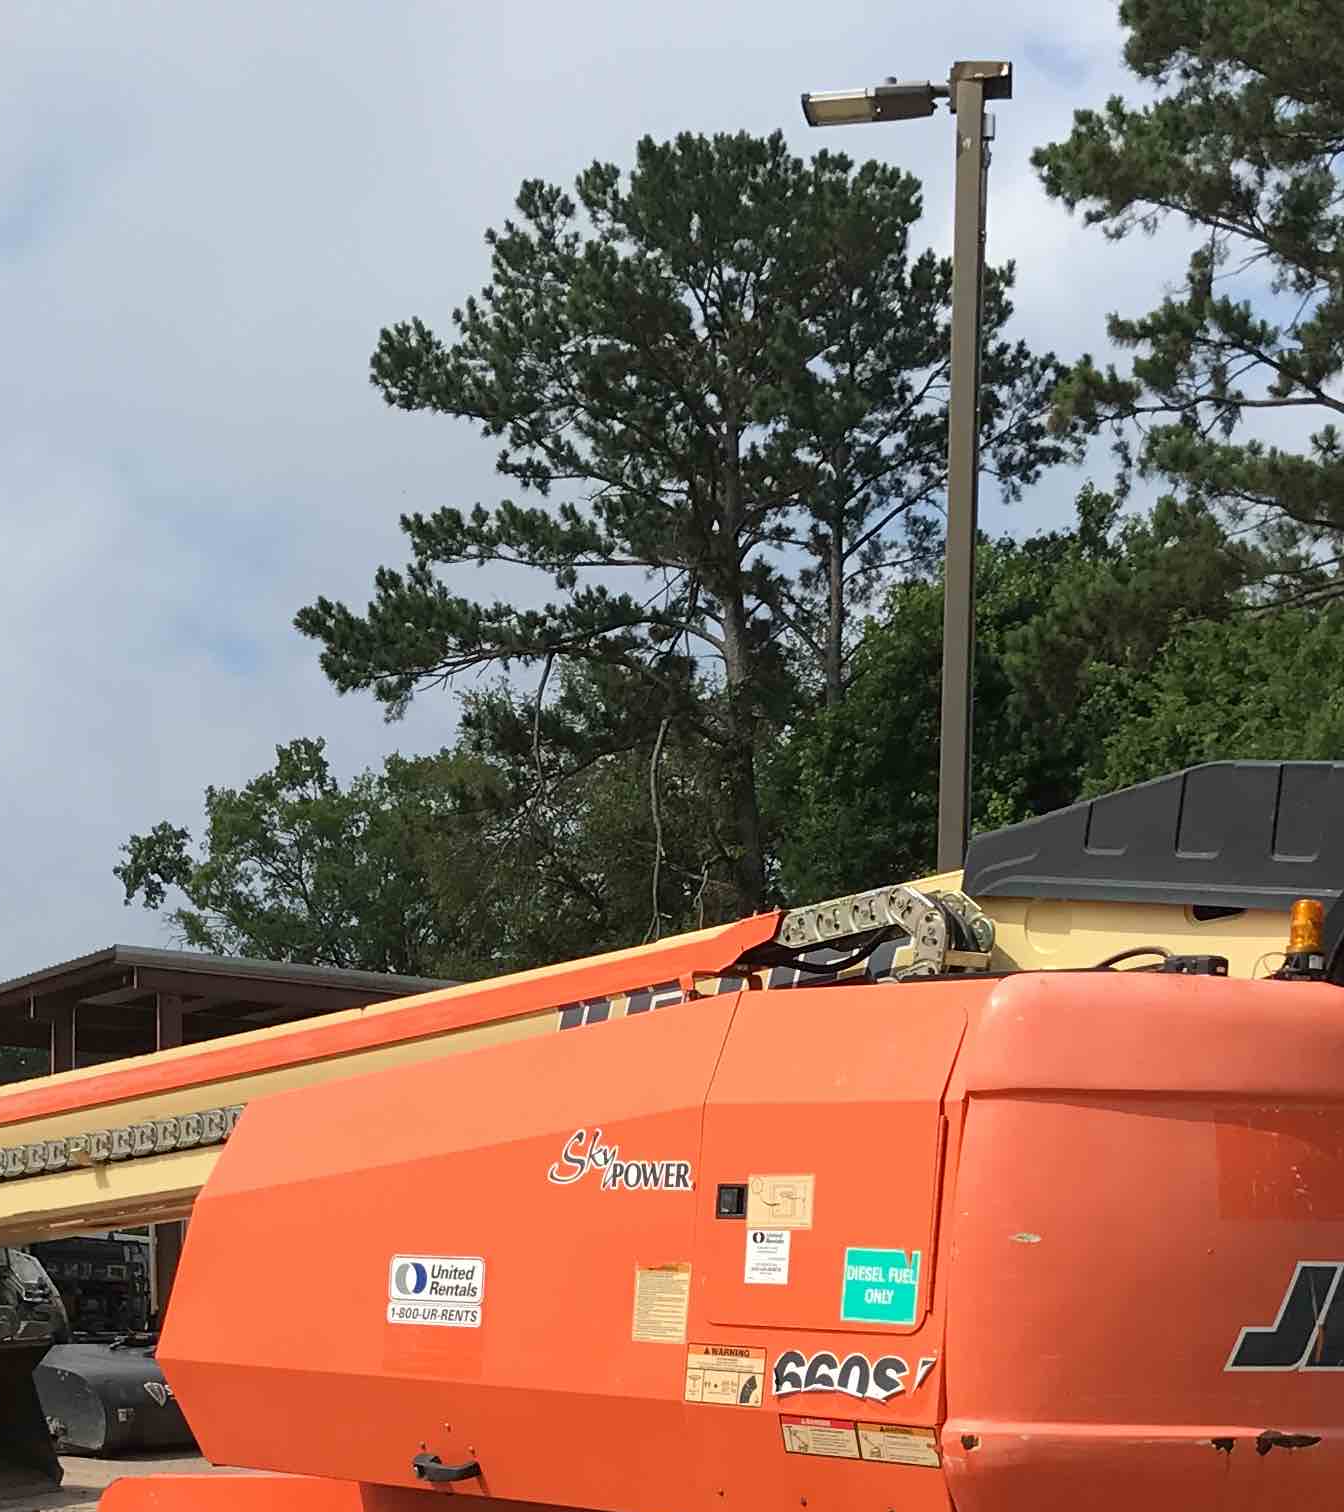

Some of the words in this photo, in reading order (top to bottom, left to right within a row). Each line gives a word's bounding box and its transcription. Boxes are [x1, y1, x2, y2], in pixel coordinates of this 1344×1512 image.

[547, 1129, 619, 1190] Sky
[610, 1162, 691, 1190] POWER
[431, 1263, 476, 1281] United
[846, 1264, 885, 1283] DIESEL
[888, 1266, 916, 1286] FUEL
[429, 1281, 479, 1298] Rentals
[864, 1287, 895, 1305] ONLY
[390, 1306, 479, 1323] 1-800-UR-RENTS
[711, 1347, 751, 1359] WARNING
